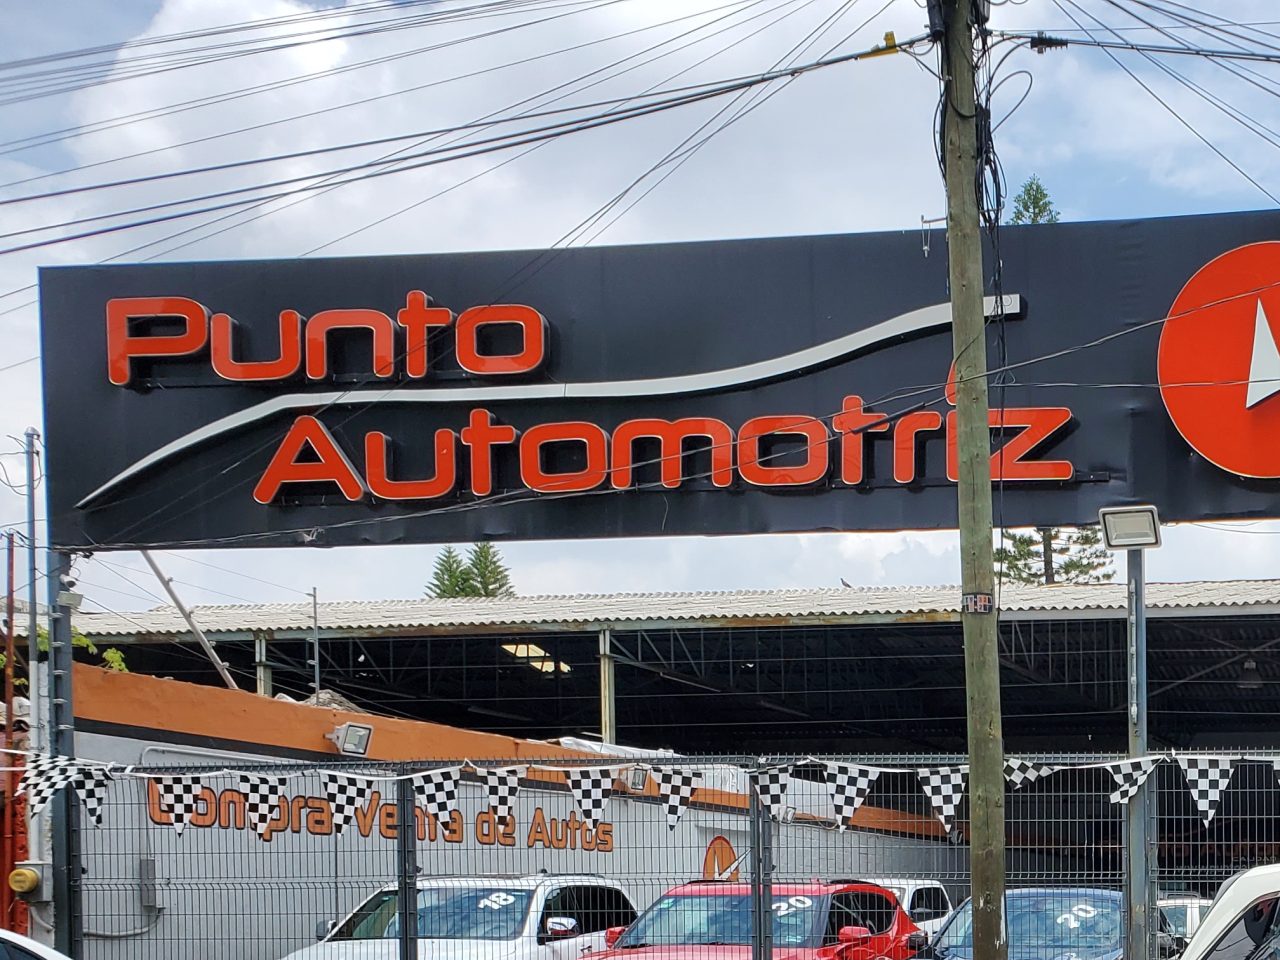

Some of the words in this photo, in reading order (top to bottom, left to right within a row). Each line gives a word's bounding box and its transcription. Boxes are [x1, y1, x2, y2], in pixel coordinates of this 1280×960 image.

[106, 290, 547, 387] Punto
[252, 357, 1075, 506] Automotriz
[475, 806, 516, 847] de
[526, 806, 614, 853] Autos
[477, 891, 516, 910] 18
[771, 895, 813, 917] 20
[1056, 904, 1098, 929] 20
